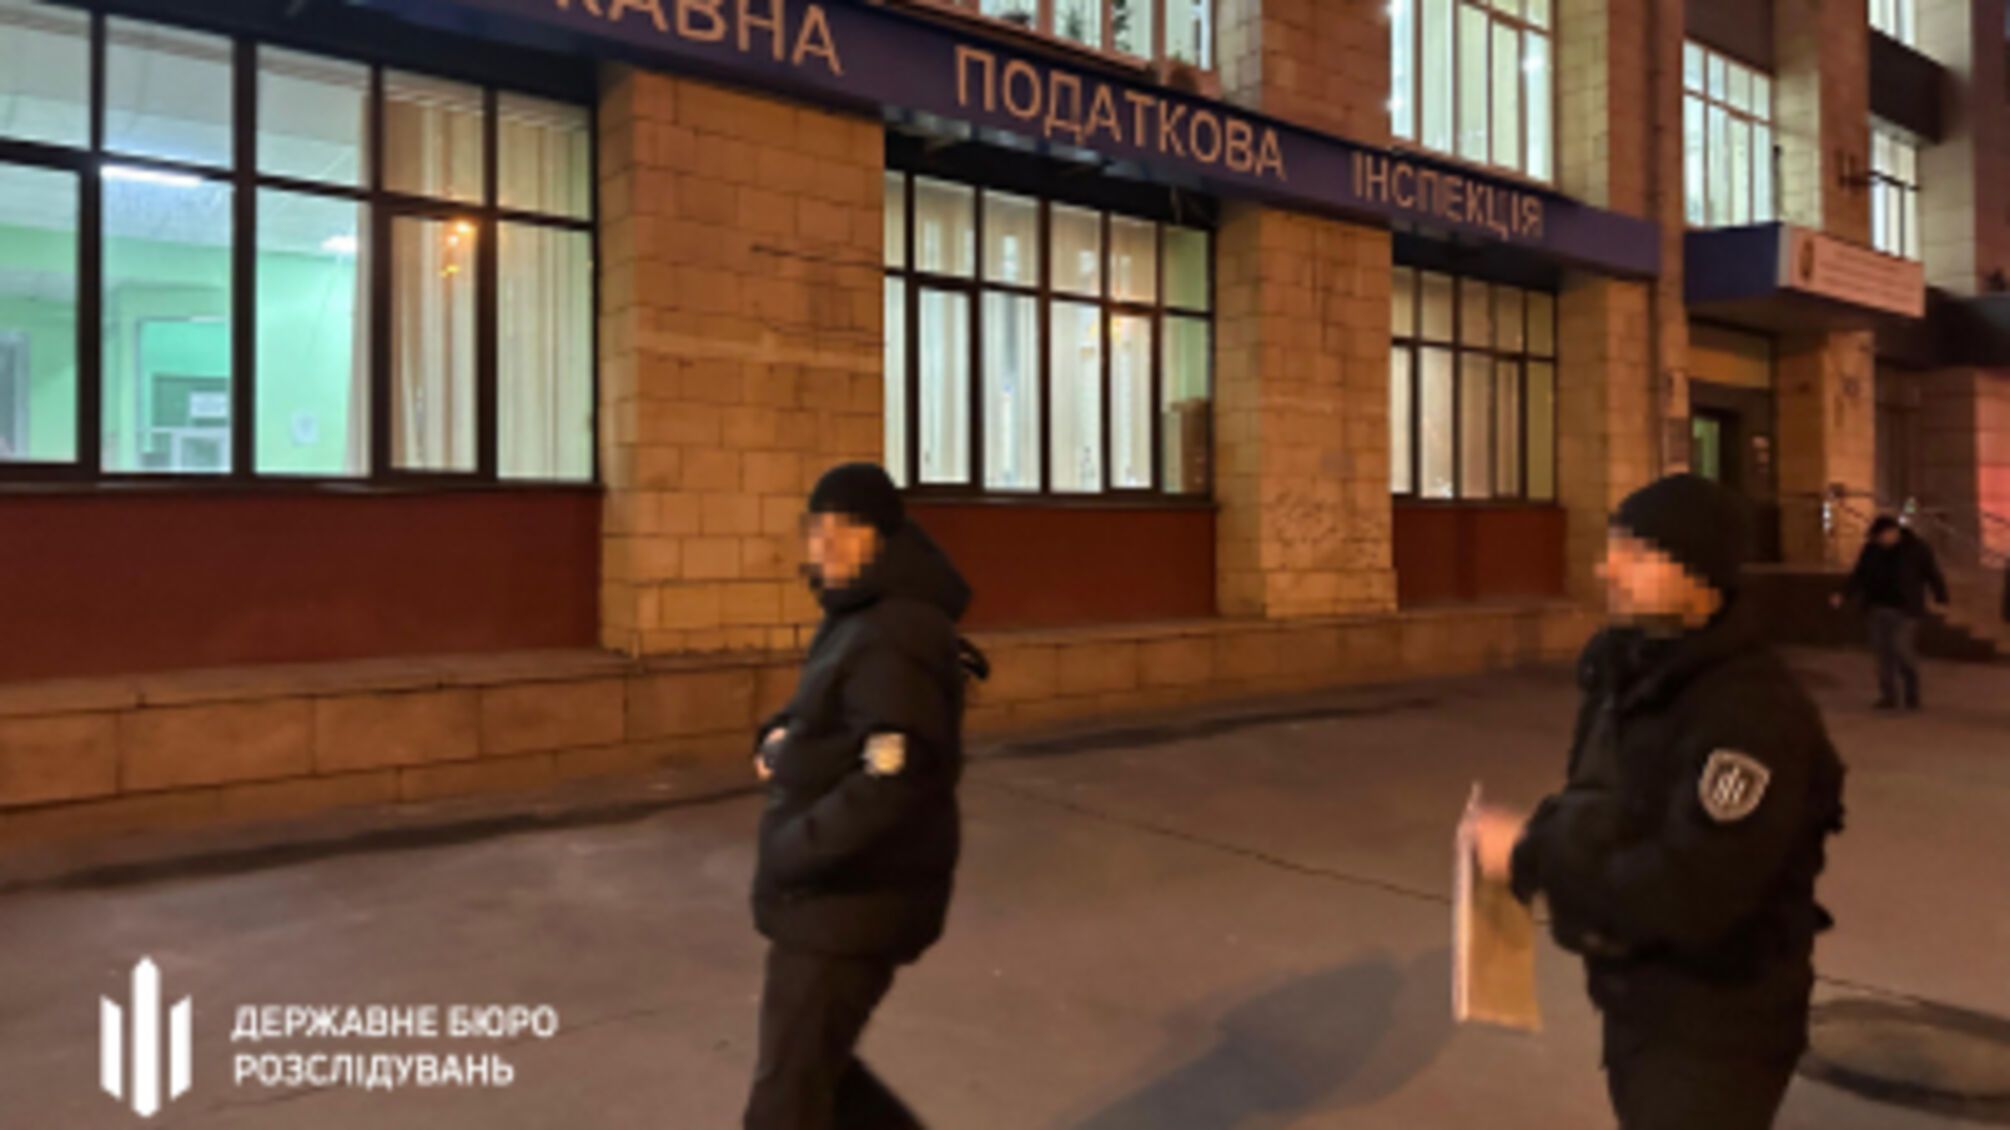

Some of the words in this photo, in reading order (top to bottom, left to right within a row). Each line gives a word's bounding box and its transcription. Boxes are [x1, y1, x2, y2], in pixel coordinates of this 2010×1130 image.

[555, 0, 844, 76] ВНА
[956, 46, 1286, 180] ПОДАТКОВА
[1353, 152, 1543, 241] ІНСПЕКЦІЯ
